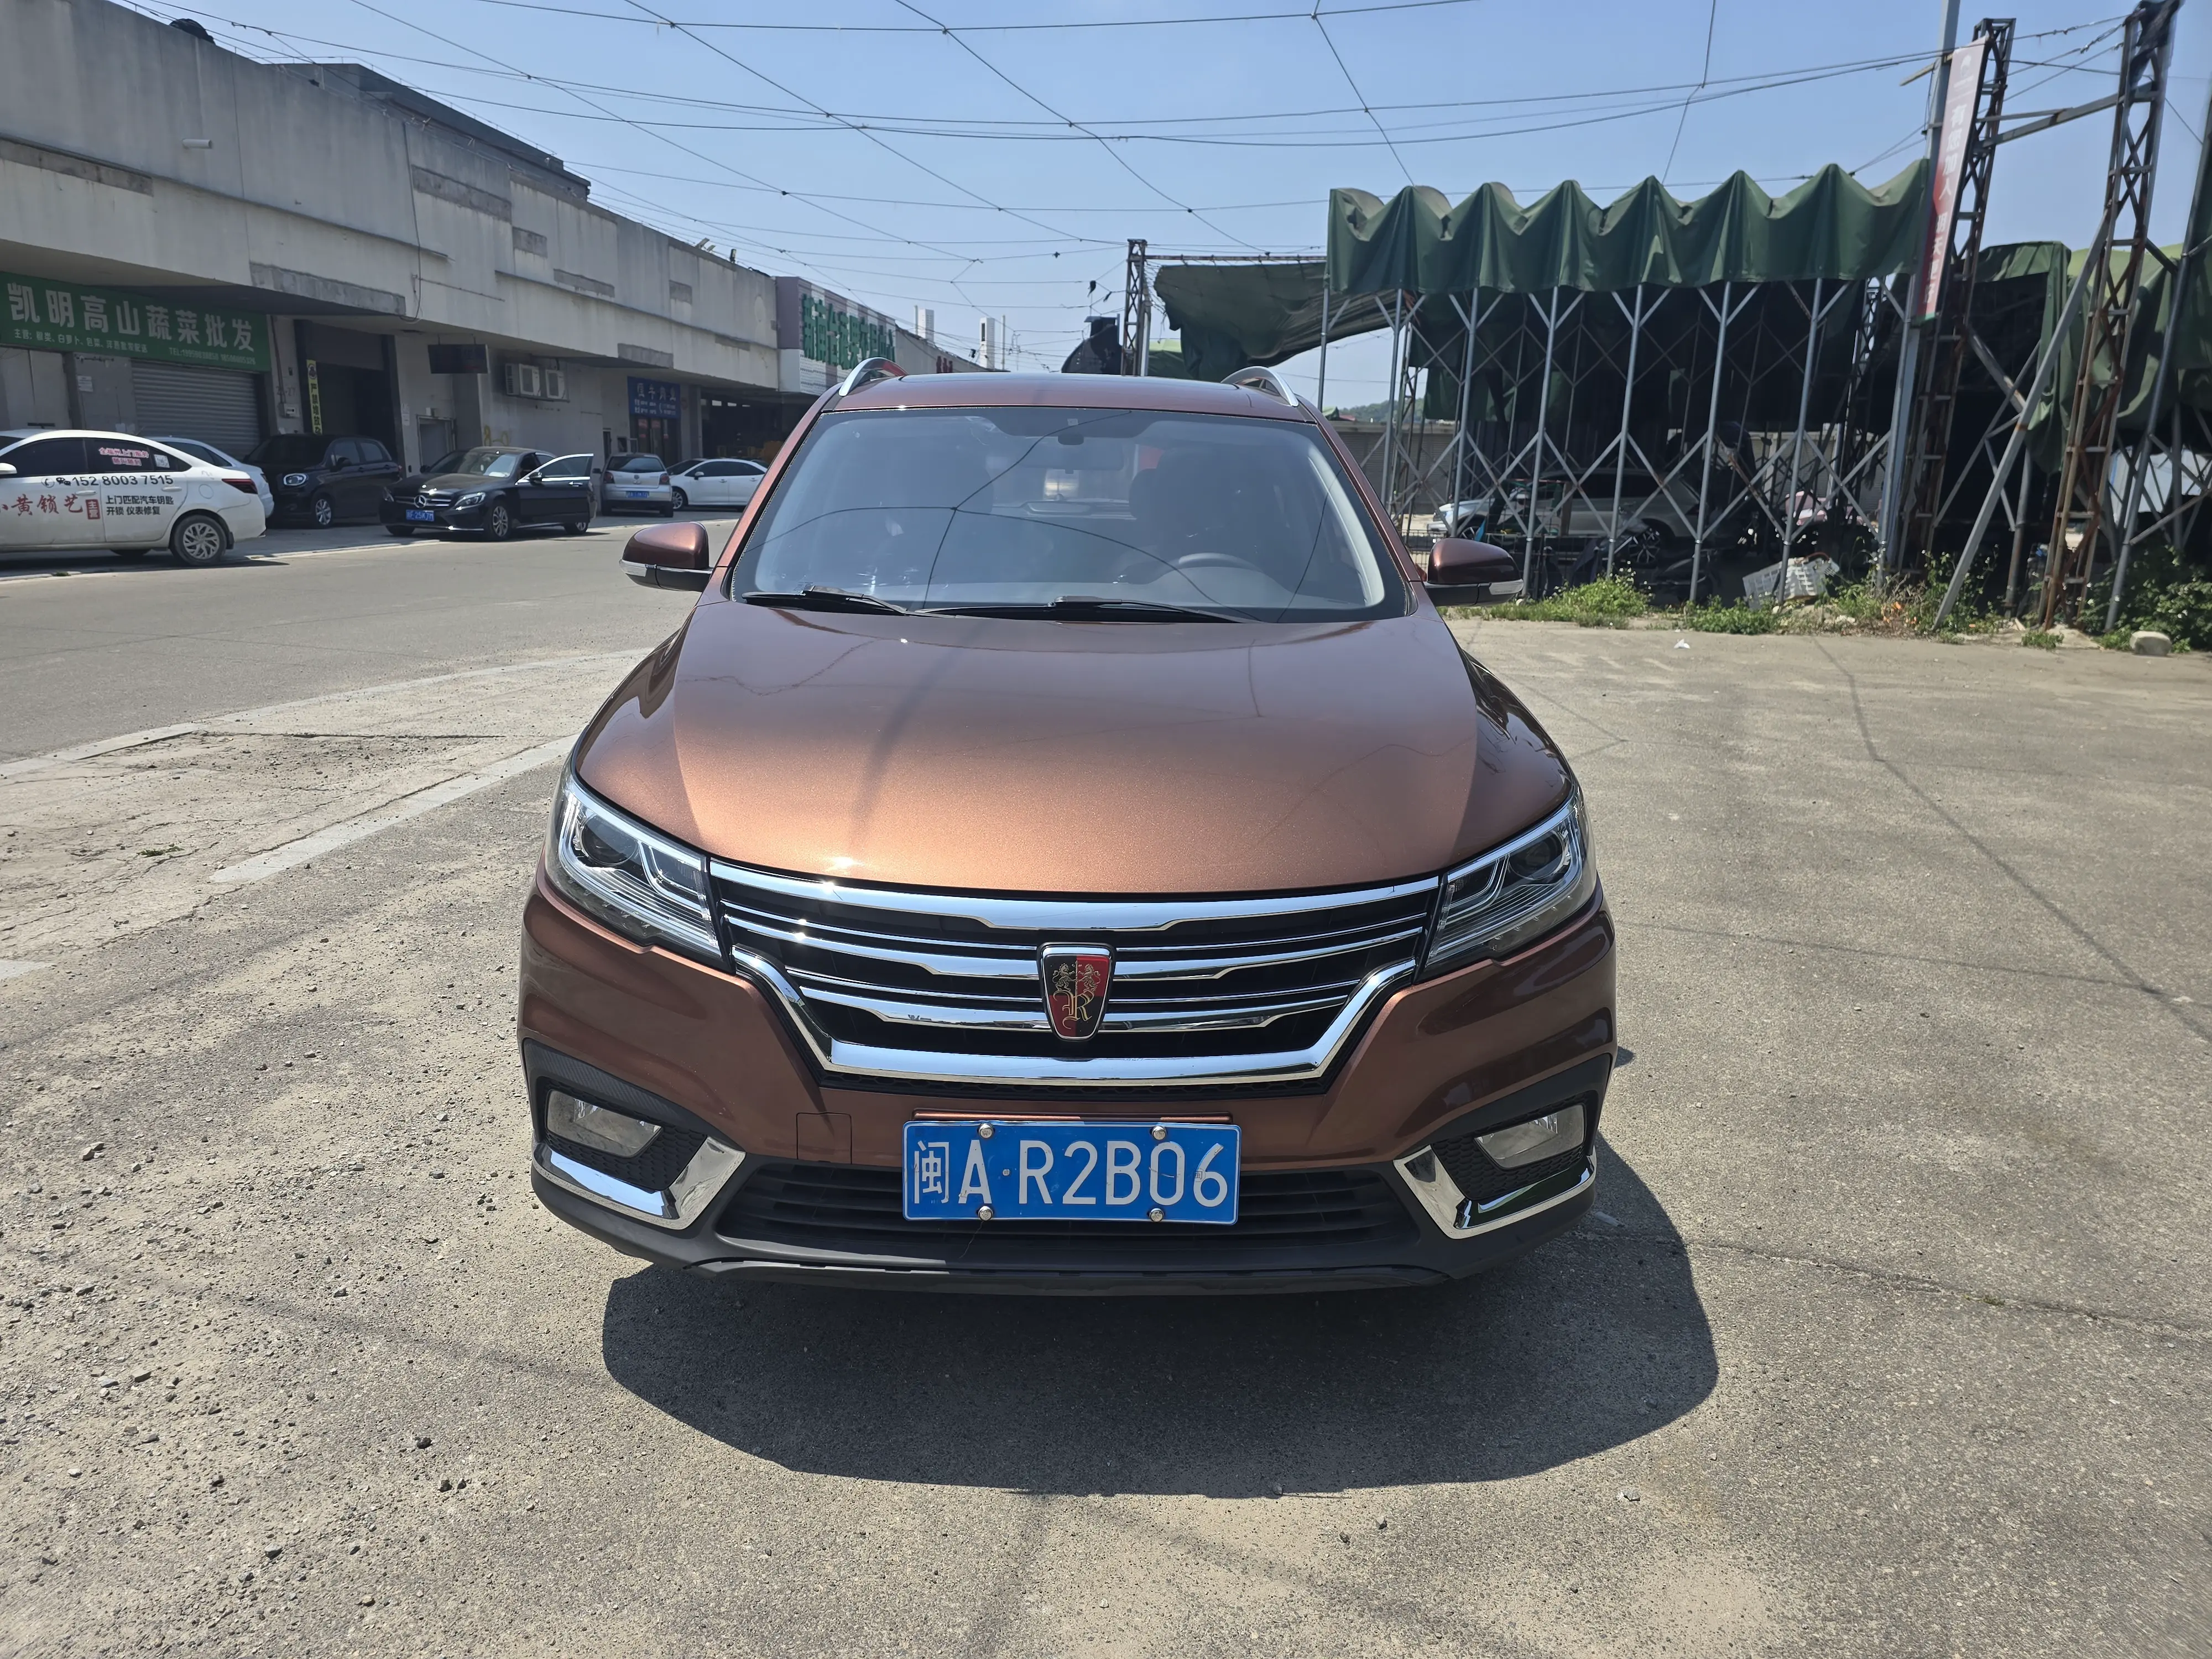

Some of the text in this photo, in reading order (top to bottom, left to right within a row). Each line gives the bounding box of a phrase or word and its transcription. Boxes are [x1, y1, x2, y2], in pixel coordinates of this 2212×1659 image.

[8, 282, 254, 352] 凯明高山蔬菜批发
[72, 475, 174, 487] 152 8003 7515
[105, 495, 174, 505] 上门匹配汽车钥匙
[107, 506, 161, 516] 开锁 仪表修复
